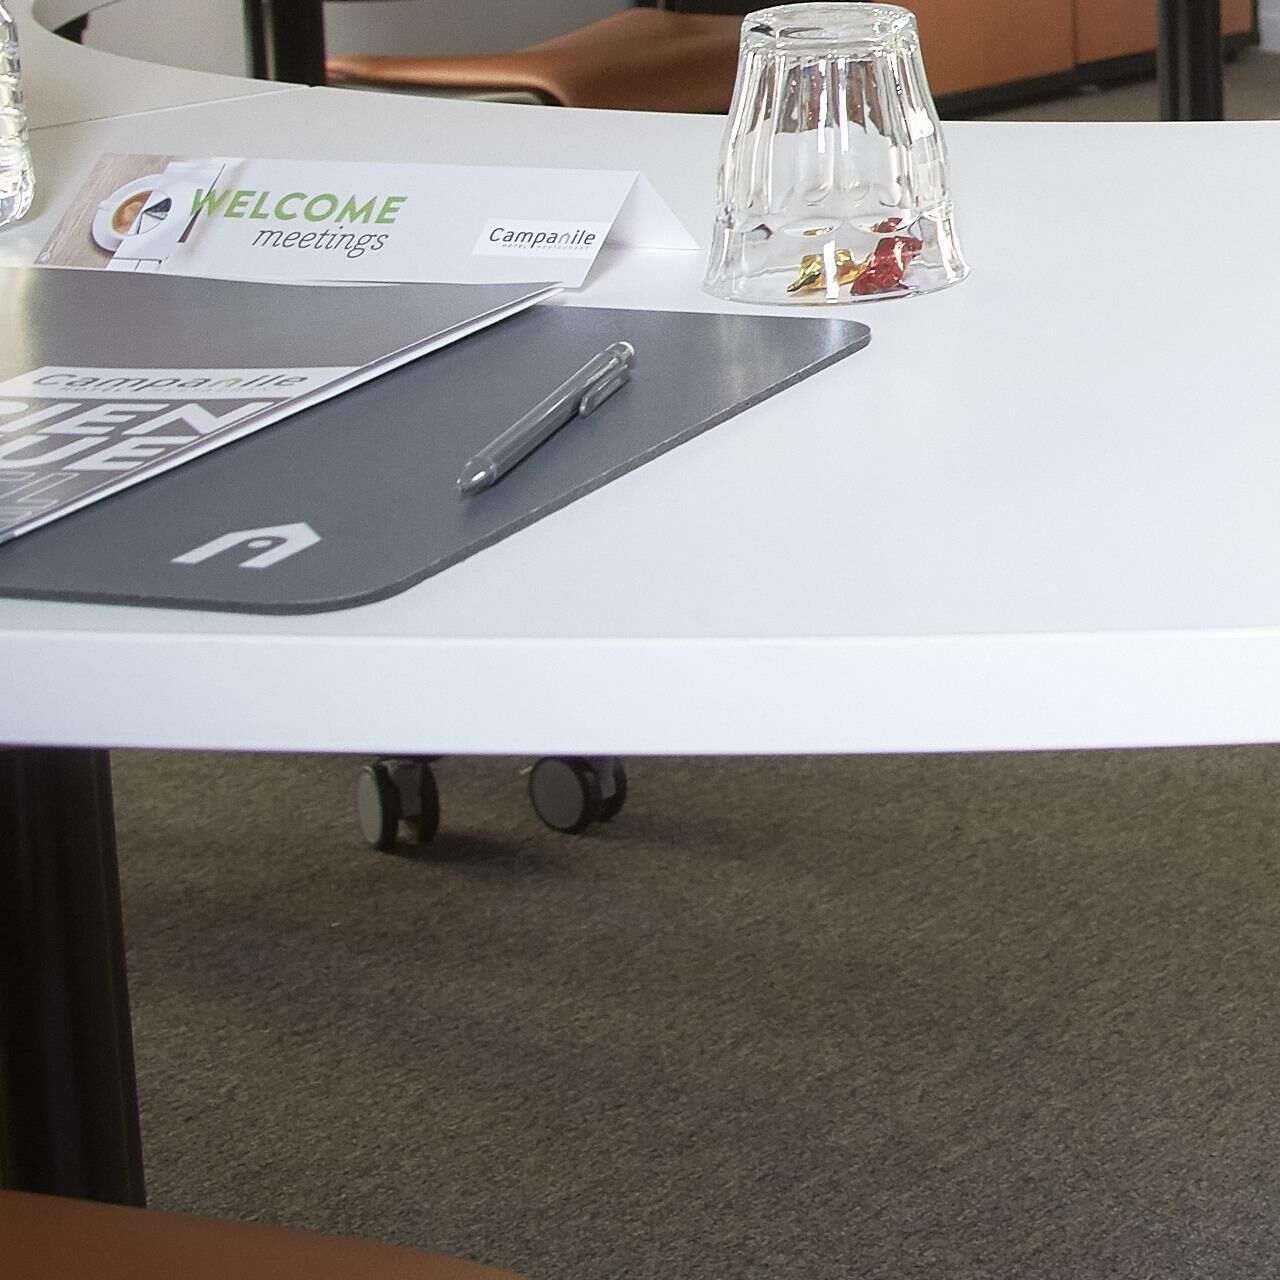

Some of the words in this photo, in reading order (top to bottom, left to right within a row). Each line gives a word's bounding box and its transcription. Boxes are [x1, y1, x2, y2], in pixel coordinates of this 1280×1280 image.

[190, 188, 408, 224] WELCOME
[252, 225, 390, 259] meetings
[489, 227, 596, 248] Campanile
[33, 373, 308, 392] Campanile
[0, 435, 200, 470] UE
